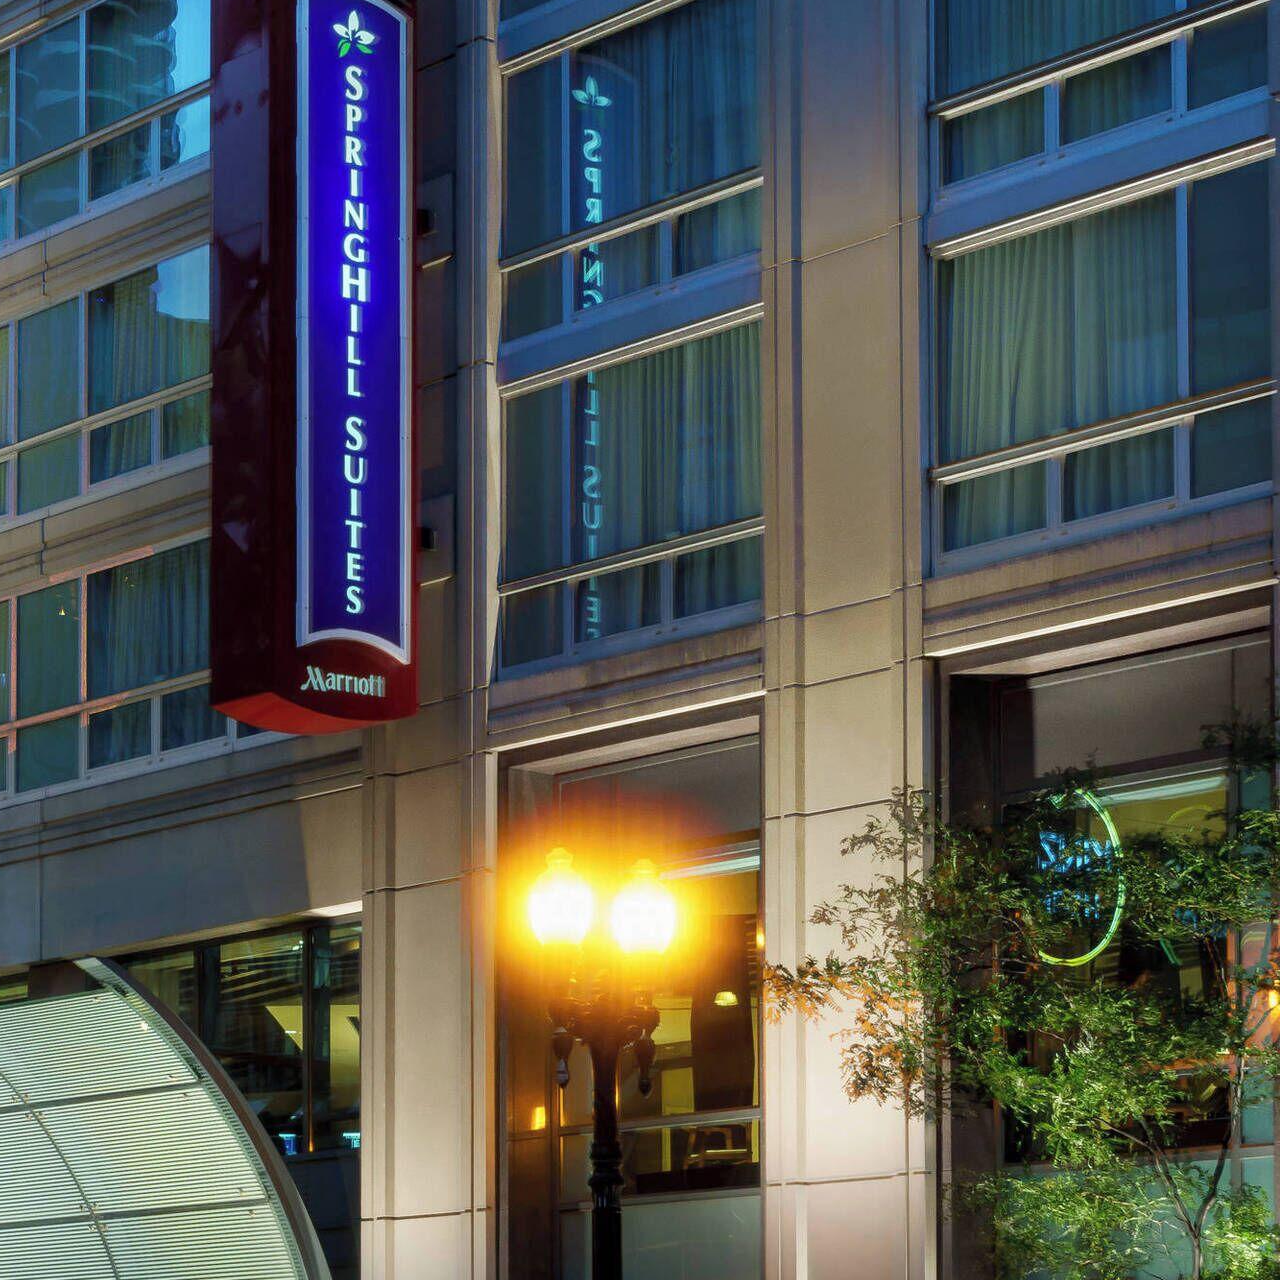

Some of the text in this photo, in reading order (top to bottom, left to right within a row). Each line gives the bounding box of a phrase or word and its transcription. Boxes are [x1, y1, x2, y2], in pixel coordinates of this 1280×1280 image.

[342, 65, 368, 614] SPRINGHILL SUITES
[300, 665, 386, 698] Marriott
